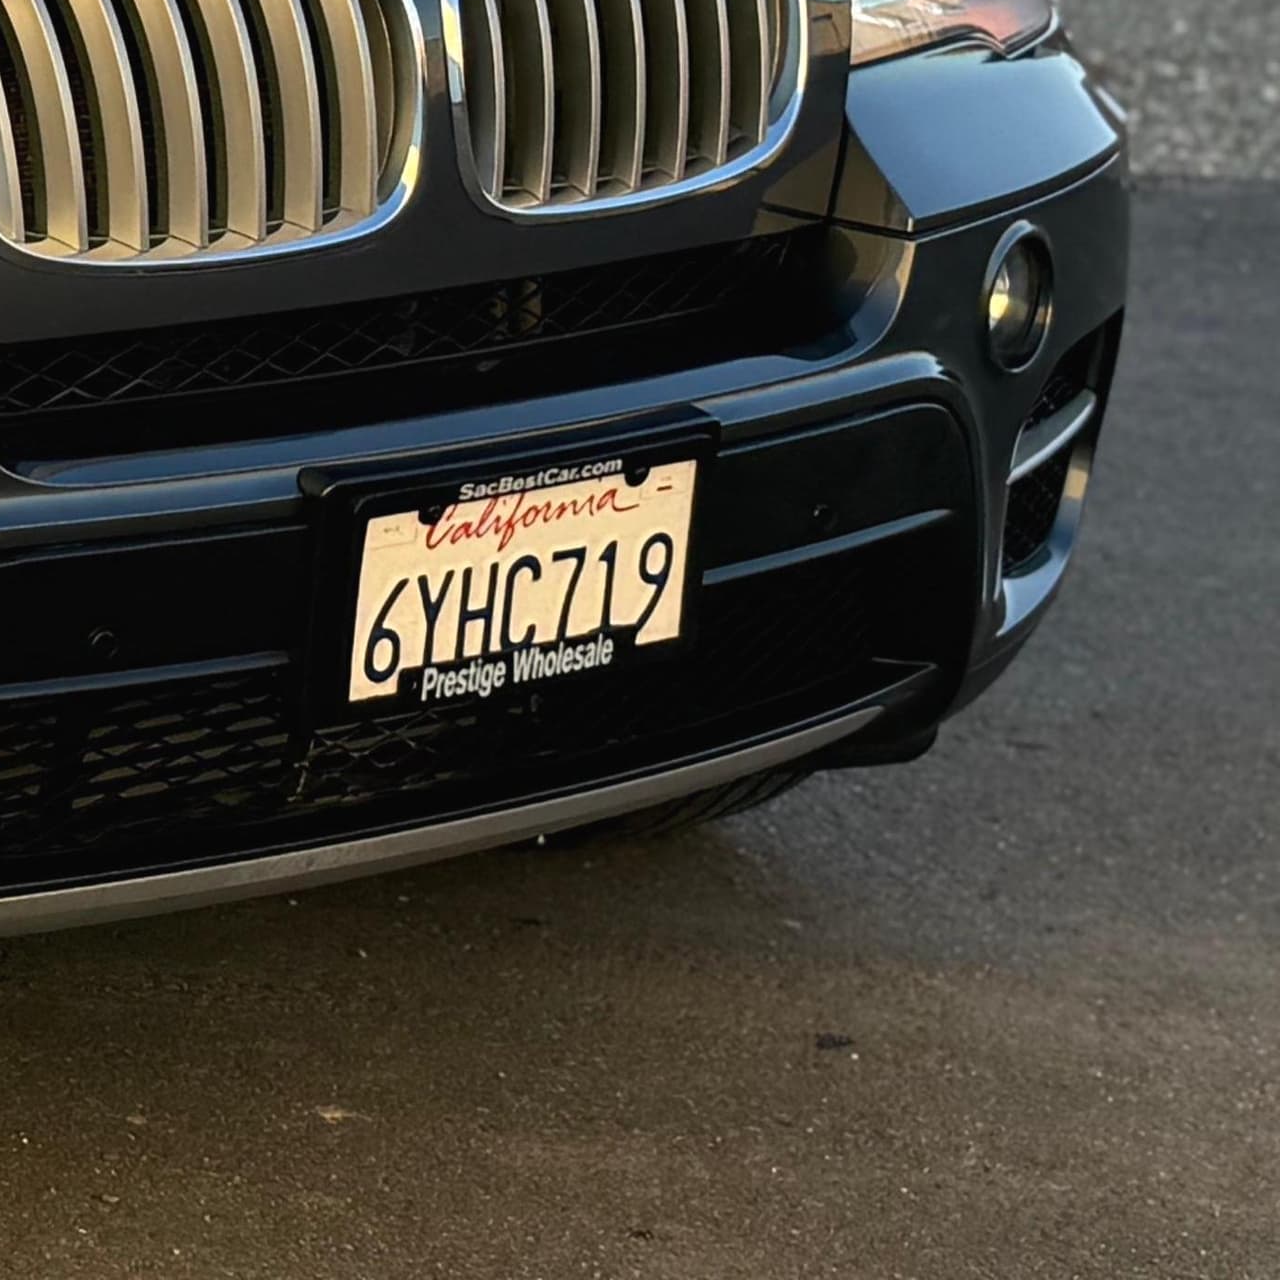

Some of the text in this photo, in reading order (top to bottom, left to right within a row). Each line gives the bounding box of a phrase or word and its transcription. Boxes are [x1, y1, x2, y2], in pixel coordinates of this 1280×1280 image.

[458, 458, 623, 502] SacBestCar.com
[425, 486, 640, 551] California
[363, 532, 674, 684] 6YHC719
[420, 633, 614, 702] Prestige Wholesale
